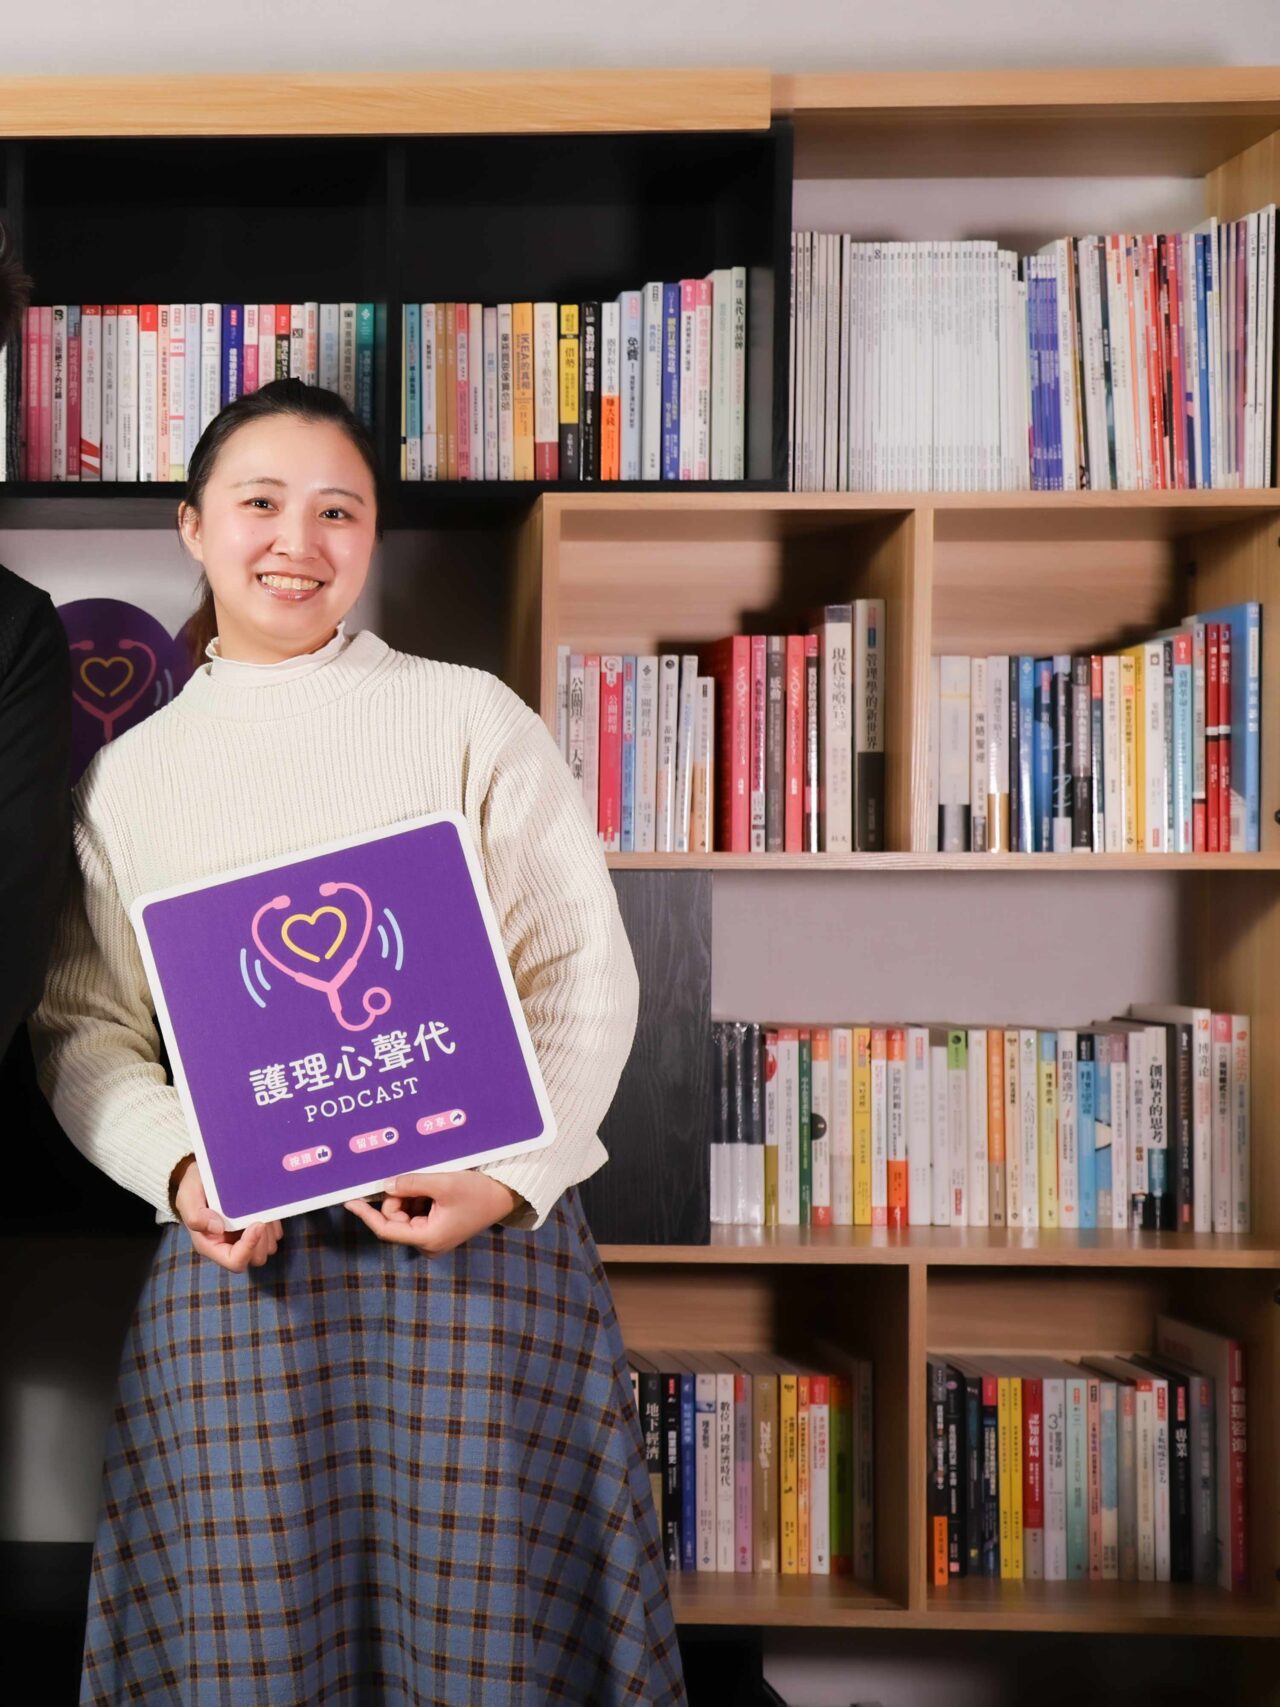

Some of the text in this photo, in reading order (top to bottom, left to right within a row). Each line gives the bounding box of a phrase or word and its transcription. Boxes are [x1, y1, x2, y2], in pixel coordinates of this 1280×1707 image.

[865, 653, 878, 750] 管理學的新世界
[248, 1020, 456, 1107] 護理心聲代
[304, 1076, 420, 1123] PODCAST
[1149, 1063, 1164, 1144] 創新者的思考
[356, 1133, 380, 1150] 留言
[423, 1115, 447, 1132] 分享
[645, 1402, 660, 1460] 地下經濟
[720, 1401, 732, 1487] 數位口碑經濟時代
